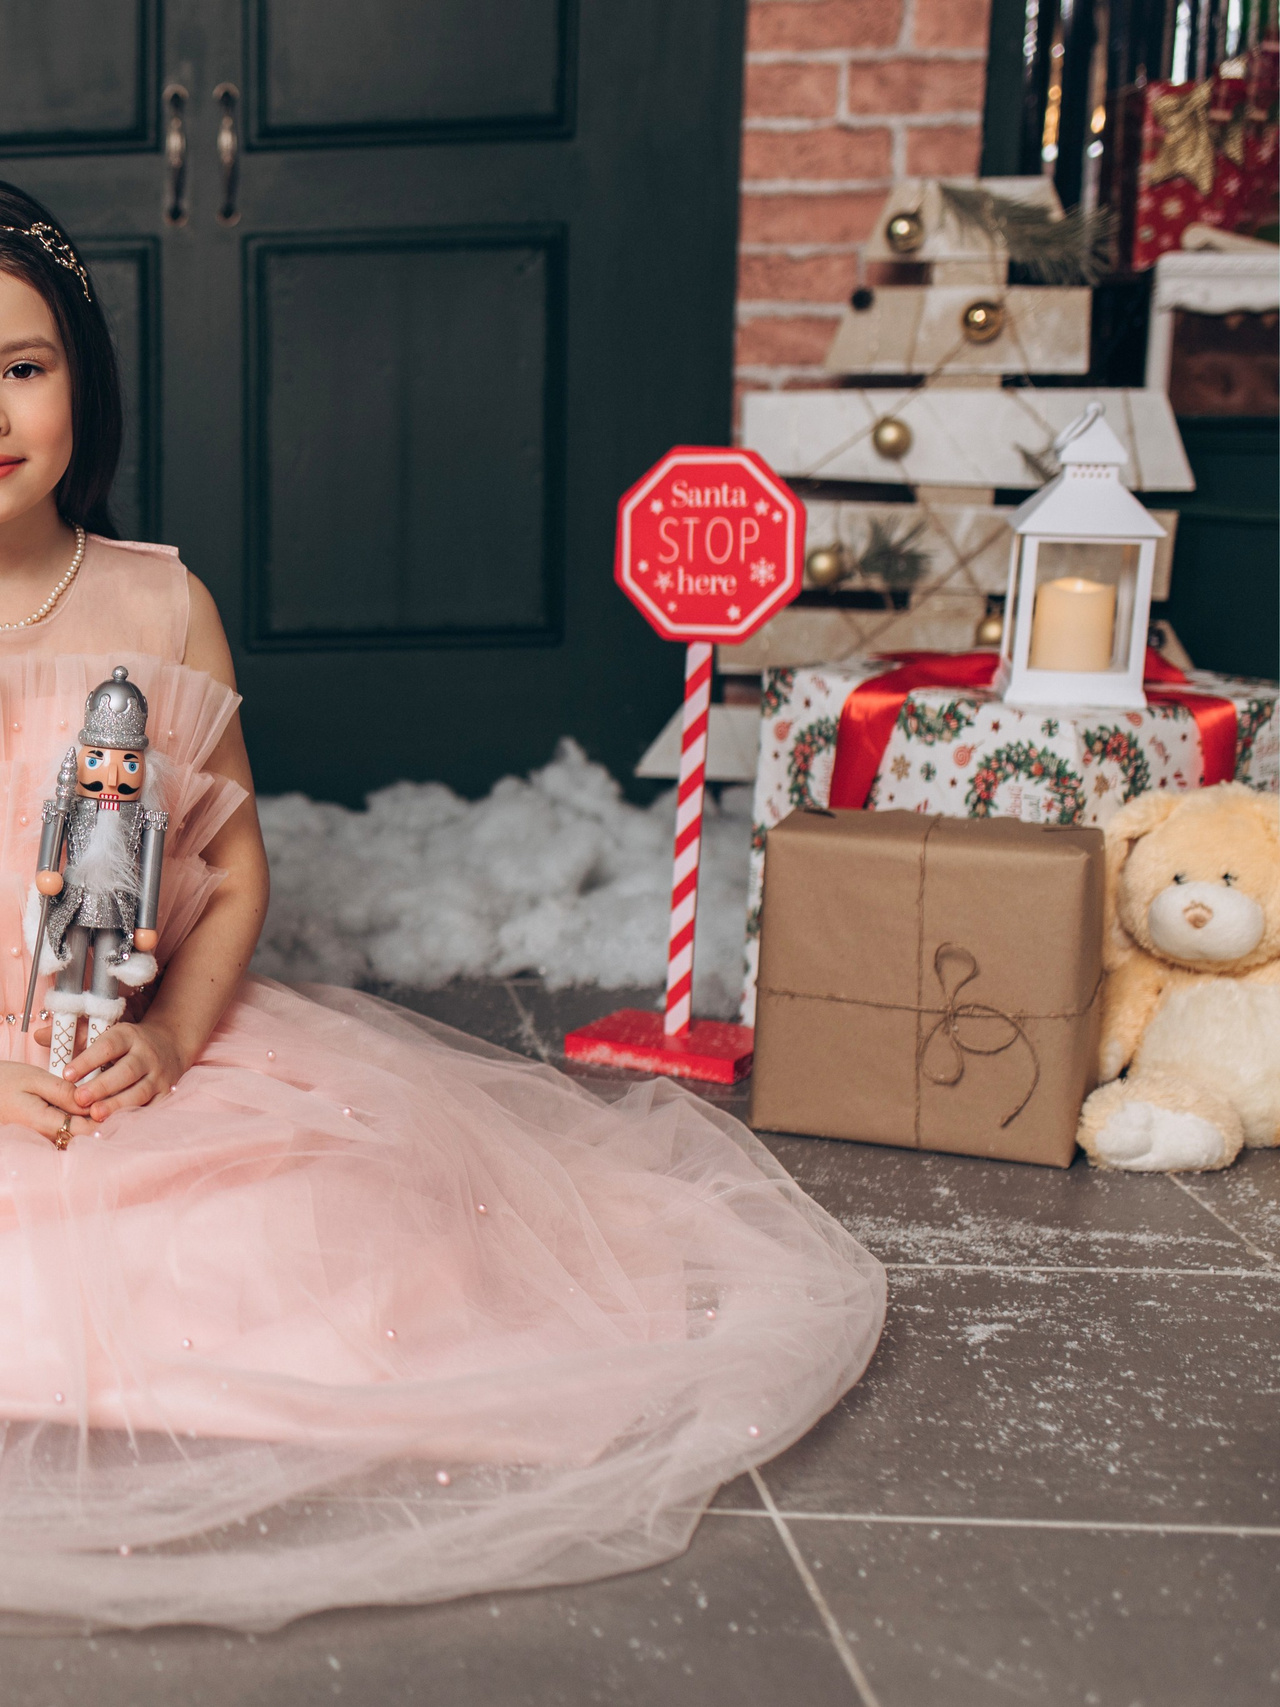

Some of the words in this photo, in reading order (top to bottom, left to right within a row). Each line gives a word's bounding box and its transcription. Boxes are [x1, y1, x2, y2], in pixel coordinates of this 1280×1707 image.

[671, 479, 748, 508] Santa
[658, 516, 760, 564] STOP
[677, 566, 738, 595] here
